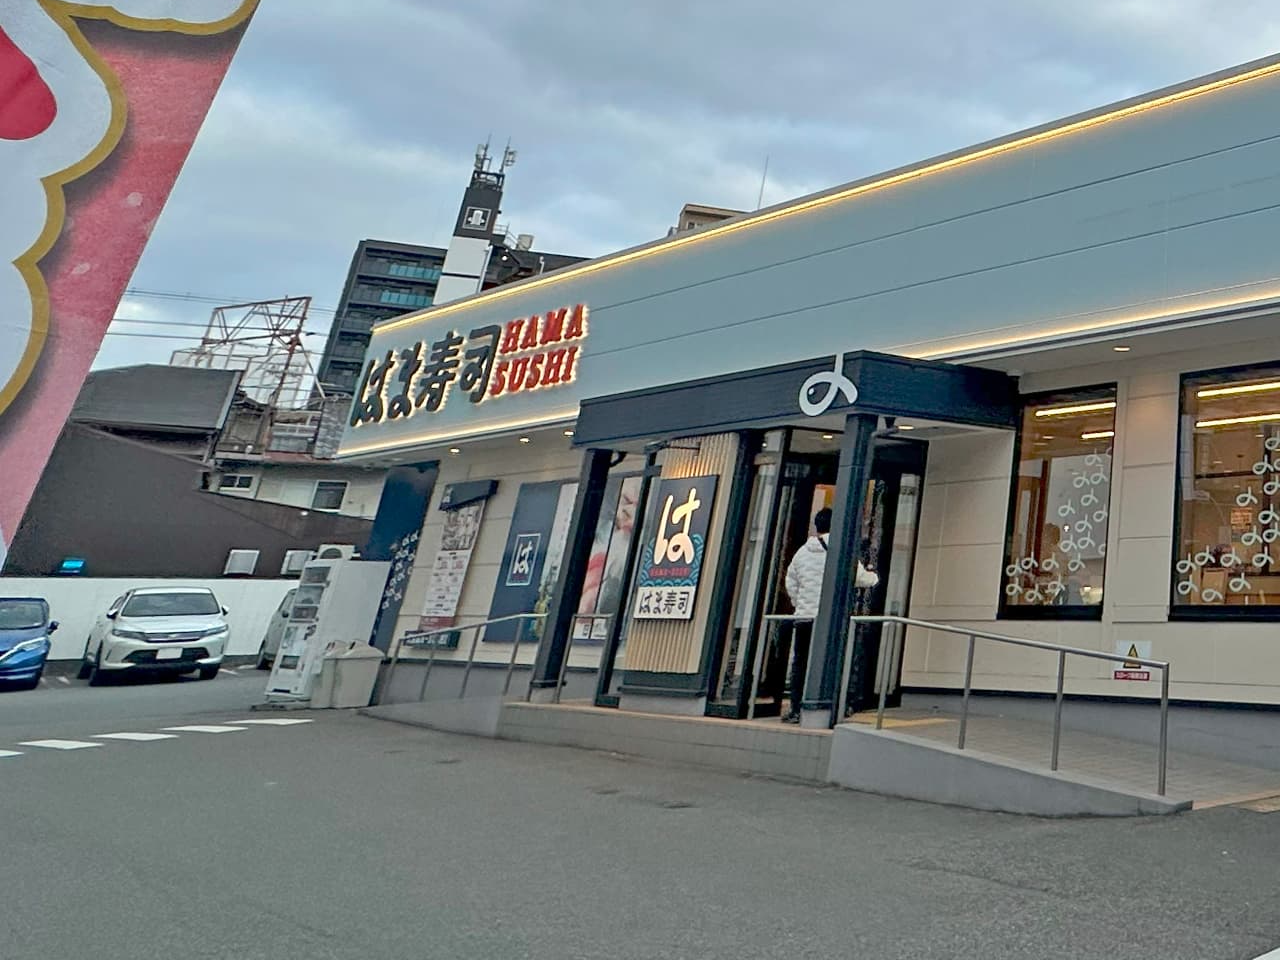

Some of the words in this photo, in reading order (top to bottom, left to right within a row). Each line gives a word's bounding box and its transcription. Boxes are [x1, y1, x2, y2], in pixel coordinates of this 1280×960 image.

[499, 304, 586, 353] HAMA
[350, 324, 502, 427] はま寿司
[489, 346, 578, 396] SUSHI
[654, 488, 700, 564] は
[512, 541, 532, 574] は
[639, 590, 689, 615] はま寿司
